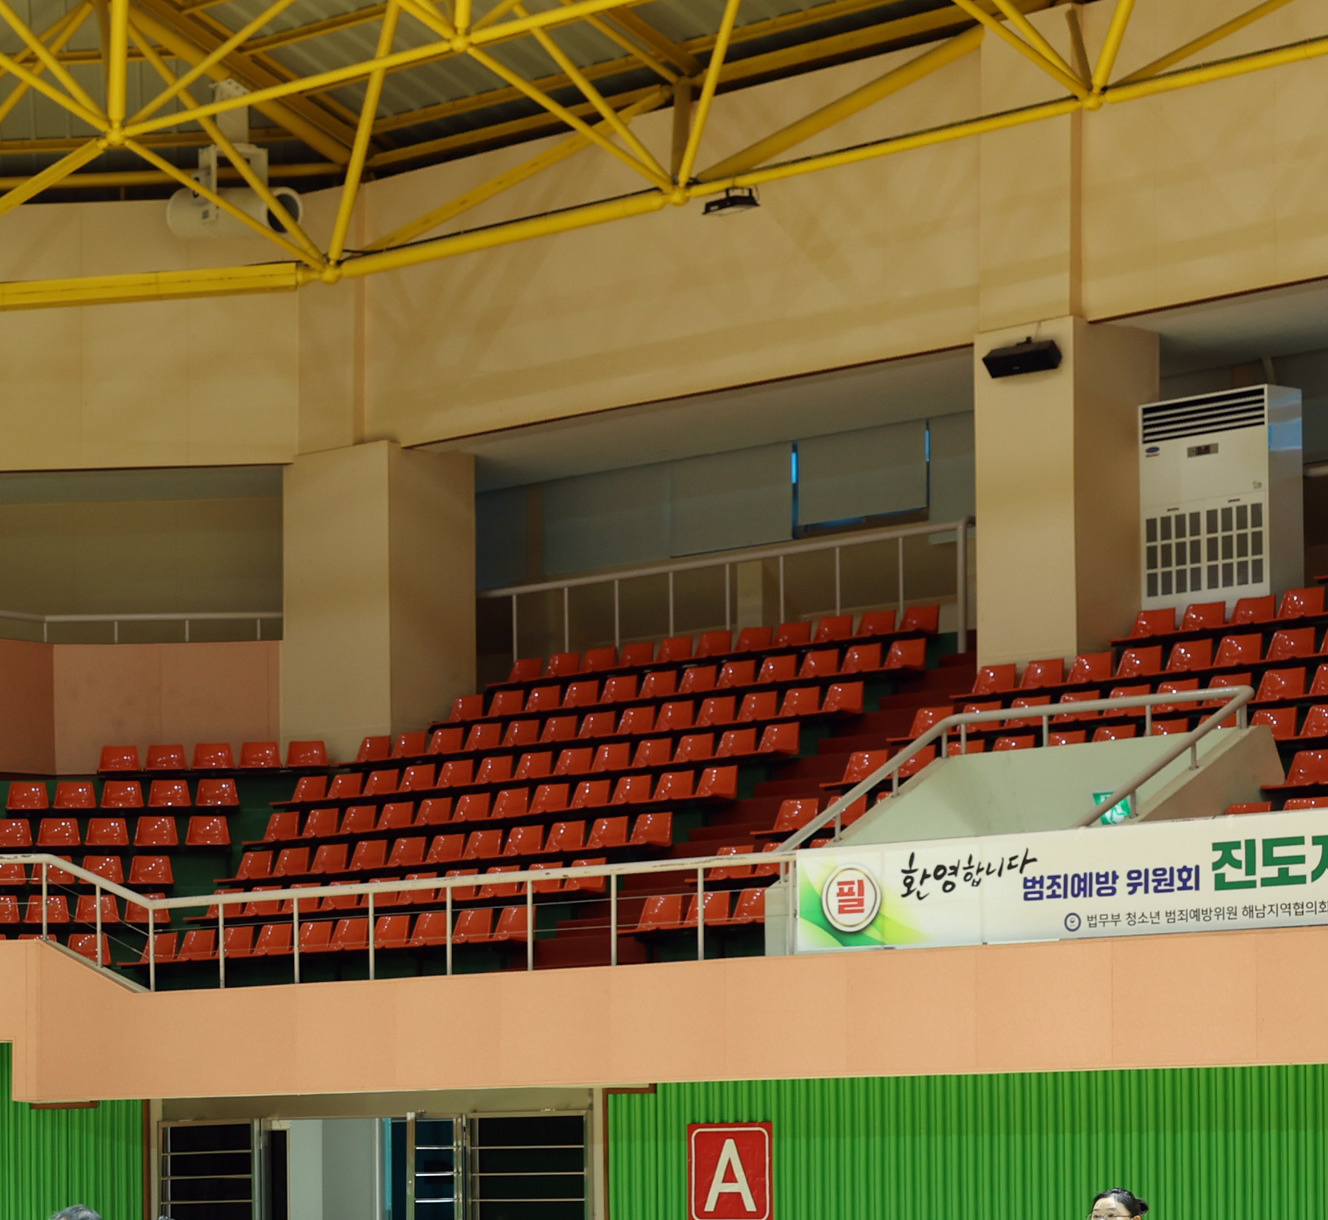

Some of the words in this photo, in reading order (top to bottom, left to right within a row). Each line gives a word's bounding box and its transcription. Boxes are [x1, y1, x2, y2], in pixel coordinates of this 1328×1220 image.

[900, 848, 1037, 901] 환영합니다
[1022, 870, 1120, 901] 범죄예방
[1126, 865, 1201, 896] 위원회
[835, 880, 866, 915] 필
[1087, 913, 1122, 928] 법무부
[1125, 910, 1161, 926] 청소년
[1164, 905, 1238, 924] 범죄예방위원
[703, 1138, 758, 1212] A
